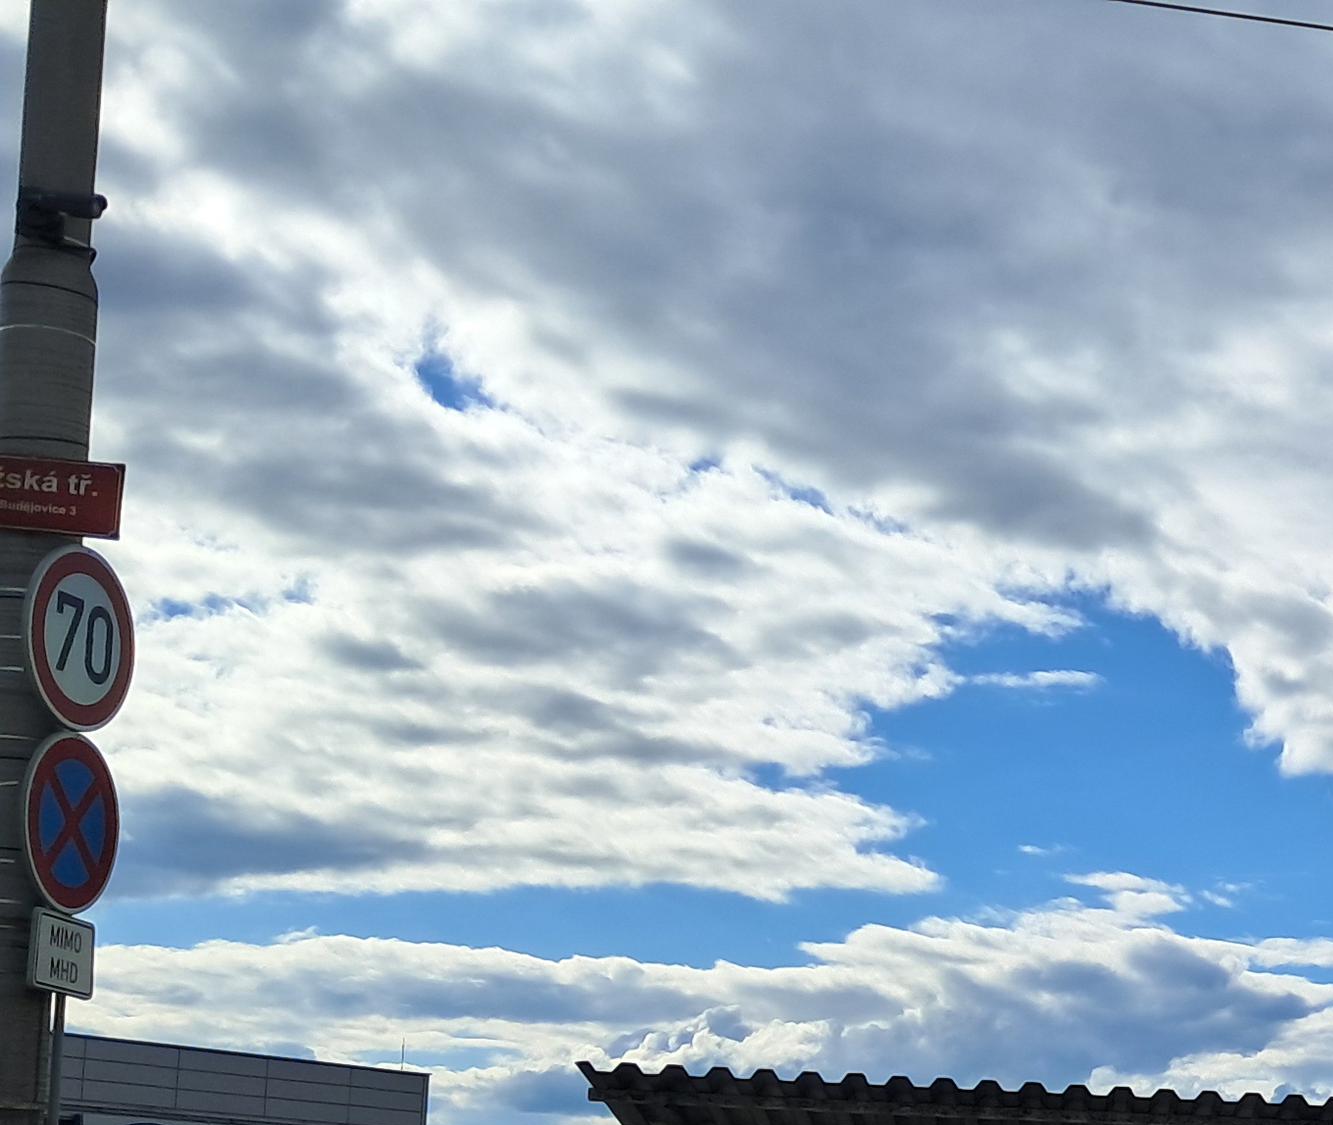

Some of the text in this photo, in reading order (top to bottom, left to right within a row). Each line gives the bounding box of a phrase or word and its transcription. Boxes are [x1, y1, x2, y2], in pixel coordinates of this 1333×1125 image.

[68, 474, 98, 497] tř.
[55, 589, 114, 685] 70
[50, 924, 82, 953] MIMO
[50, 956, 78, 984] MHD
